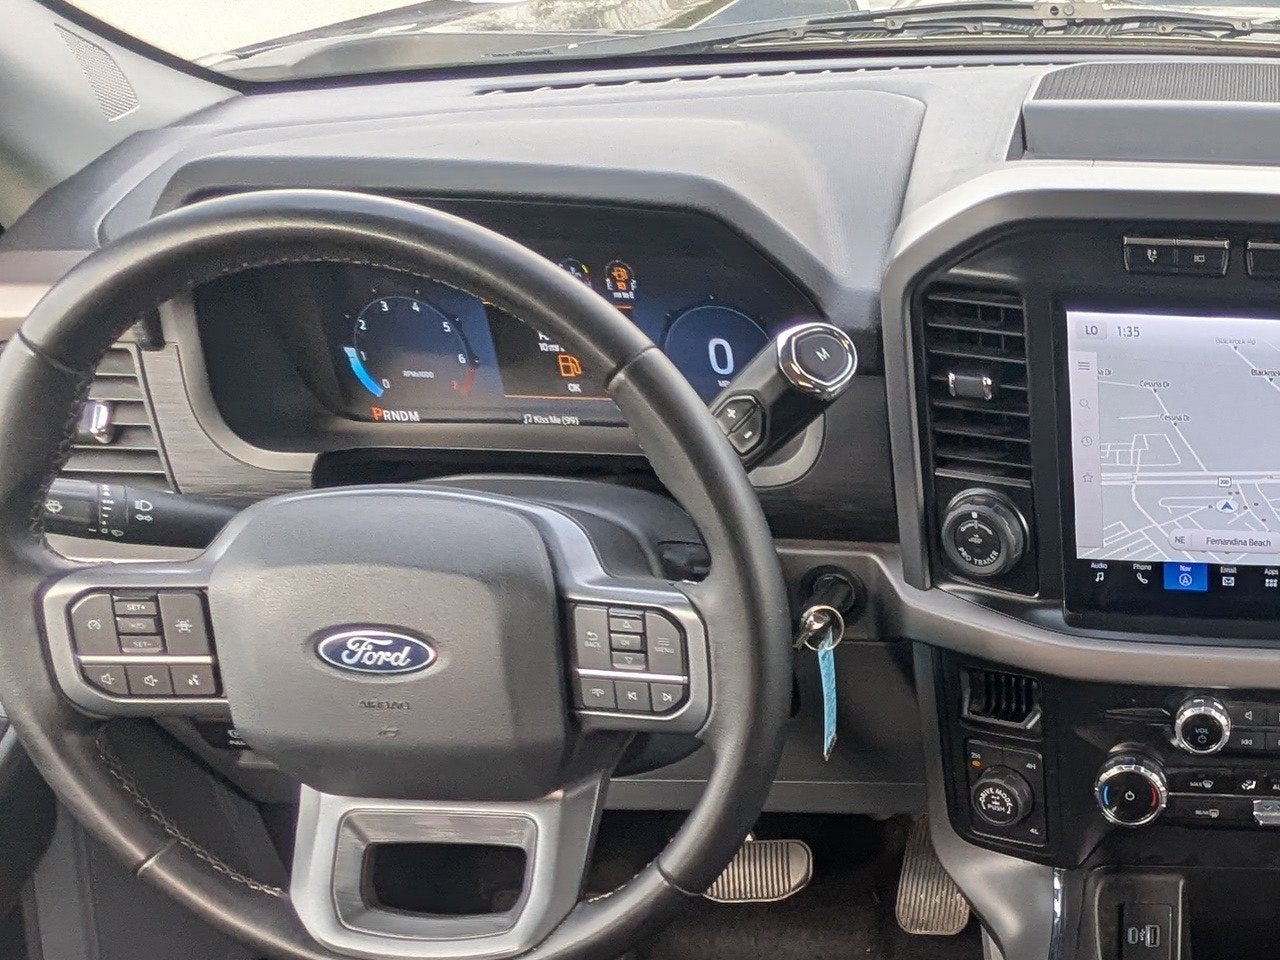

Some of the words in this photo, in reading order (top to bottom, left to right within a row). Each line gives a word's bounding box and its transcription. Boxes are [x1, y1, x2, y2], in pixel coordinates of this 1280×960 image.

[380, 300, 388, 312] 3
[412, 302, 420, 312] 4
[358, 320, 367, 330] 2
[443, 322, 450, 332] 5
[1085, 326, 1098, 336] LO
[1116, 326, 1140, 338] 1:35
[458, 354, 466, 364] 6
[708, 338, 734, 374] 0
[814, 347, 830, 362] M
[1251, 368, 1280, 376] Blackrock
[382, 378, 390, 389] 0
[568, 383, 582, 392] OK
[533, 414, 550, 424] Kiss
[1174, 536, 1186, 544] NE
[1206, 537, 1248, 546] Fernandina
[1248, 538, 1272, 546] Beach
[1090, 562, 1108, 570] Audio
[1133, 563, 1152, 571] Phone
[1220, 566, 1237, 574] Email
[1264, 568, 1279, 577] Apps
[341, 636, 412, 666] Ford
[1194, 726, 1210, 734] VOL
